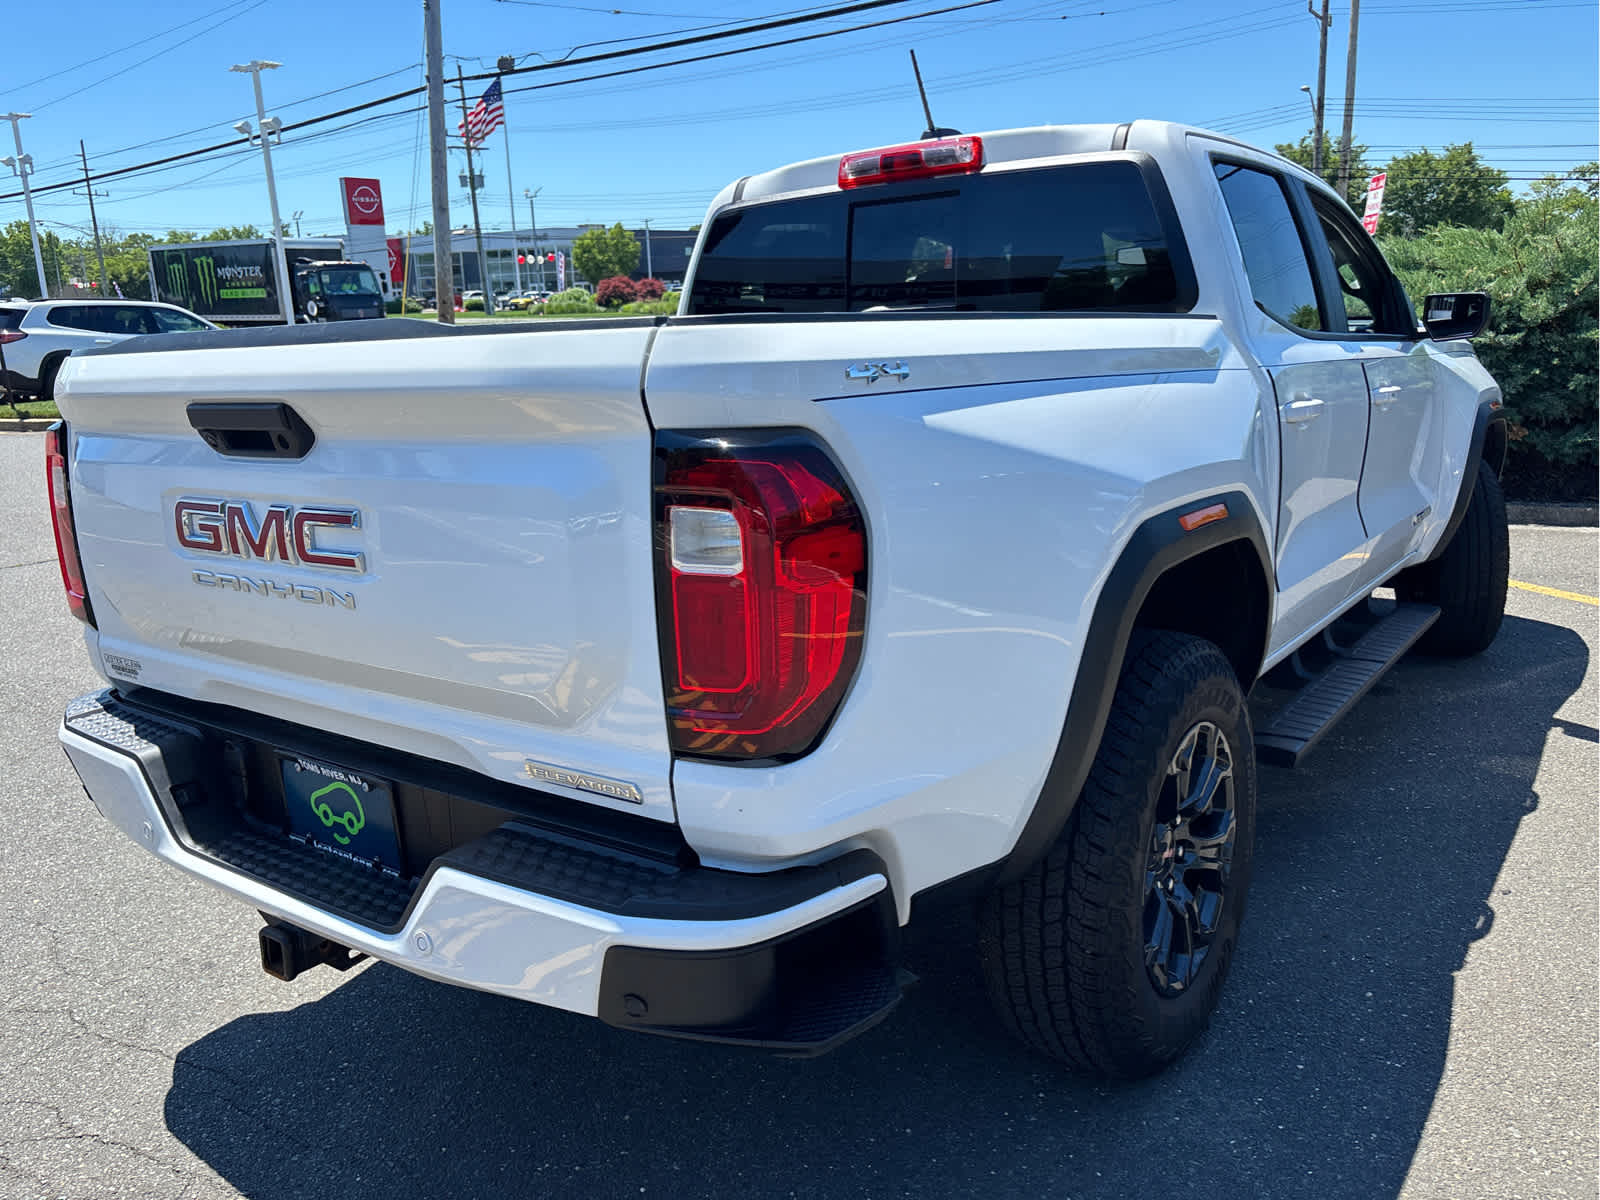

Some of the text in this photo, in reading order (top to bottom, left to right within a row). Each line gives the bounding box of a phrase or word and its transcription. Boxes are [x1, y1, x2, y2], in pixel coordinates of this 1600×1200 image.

[217, 265, 263, 280] MONSTER
[175, 496, 367, 574] GMC
[192, 568, 357, 609] CANYON
[348, 774, 362, 785] NJ
[531, 766, 632, 797] ELEVATION
